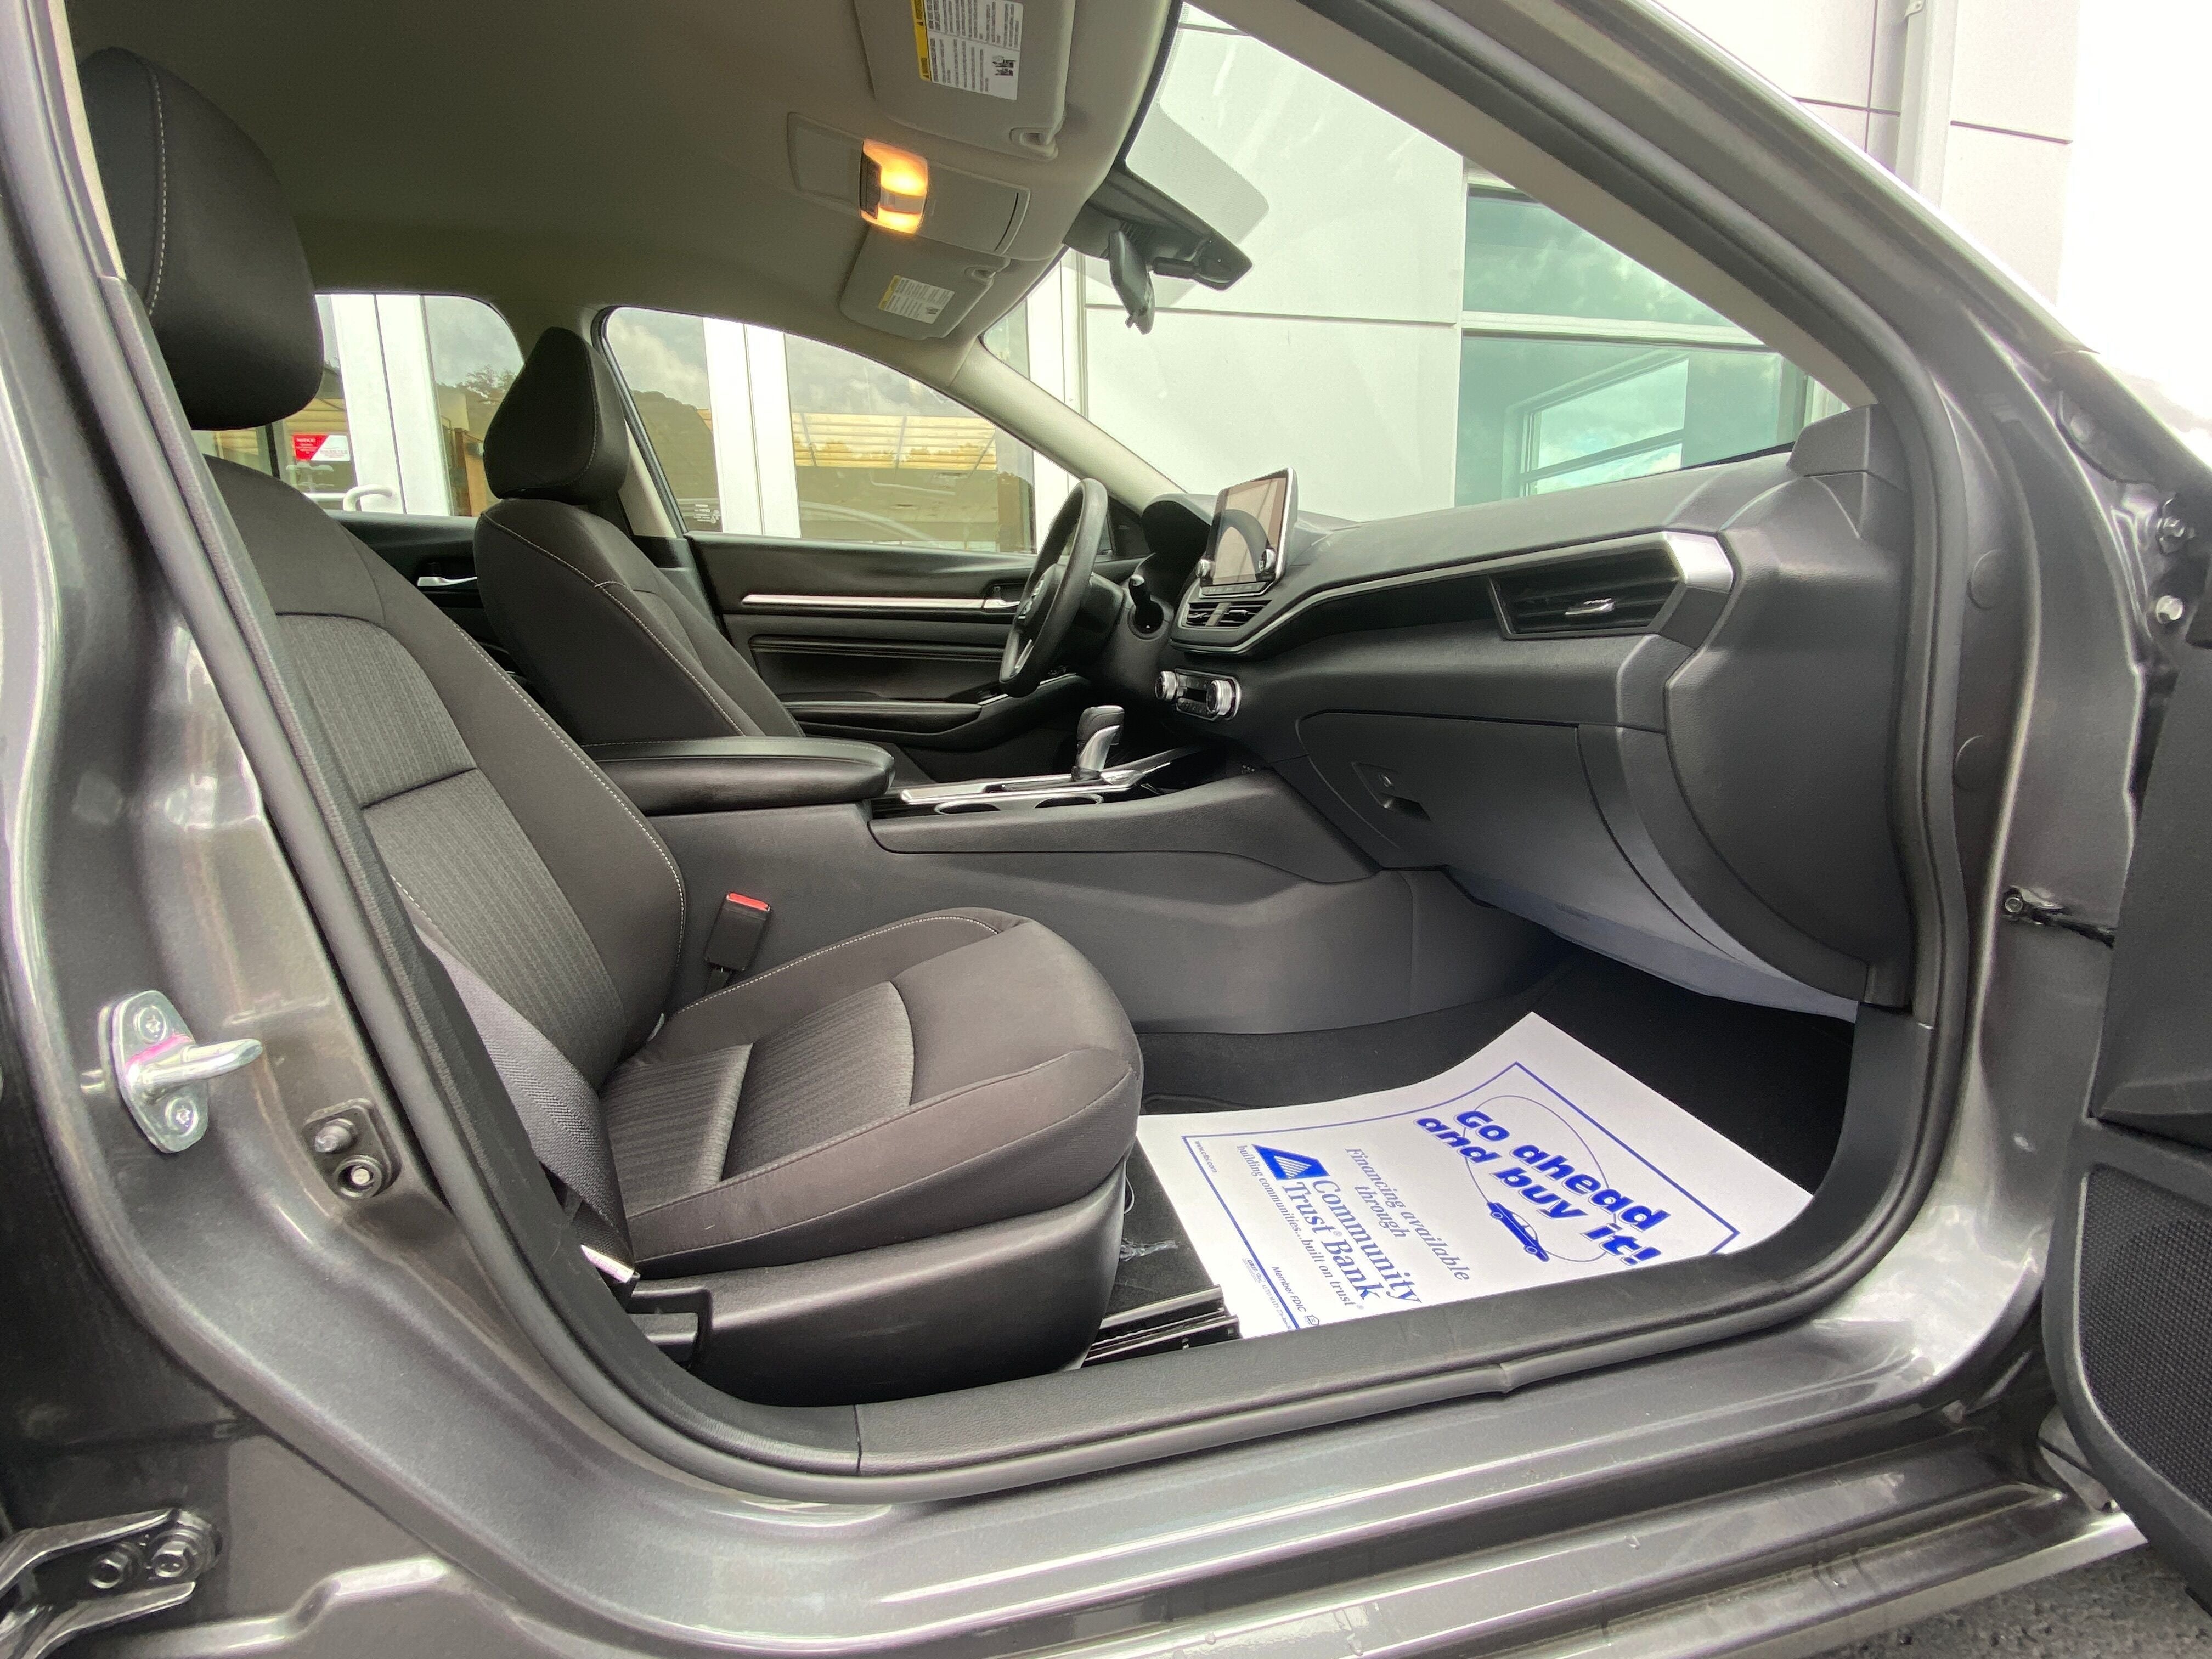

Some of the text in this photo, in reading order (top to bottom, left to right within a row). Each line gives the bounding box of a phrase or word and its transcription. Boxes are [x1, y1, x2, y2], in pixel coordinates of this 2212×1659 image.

[1237, 1145, 1263, 1177] building
[1318, 1259, 1334, 1279] on
[1345, 1148, 1470, 1280] Financing available
[1354, 1186, 1410, 1238] through
[1413, 1118, 1662, 1266] and buy it!
[1454, 1109, 1672, 1233] Go ahead
[1271, 1266, 1294, 1294] Member
[1290, 1296, 1307, 1312] FDIC
[1312, 1180, 1422, 1304] Community
[1321, 1238, 1384, 1300] Bank
